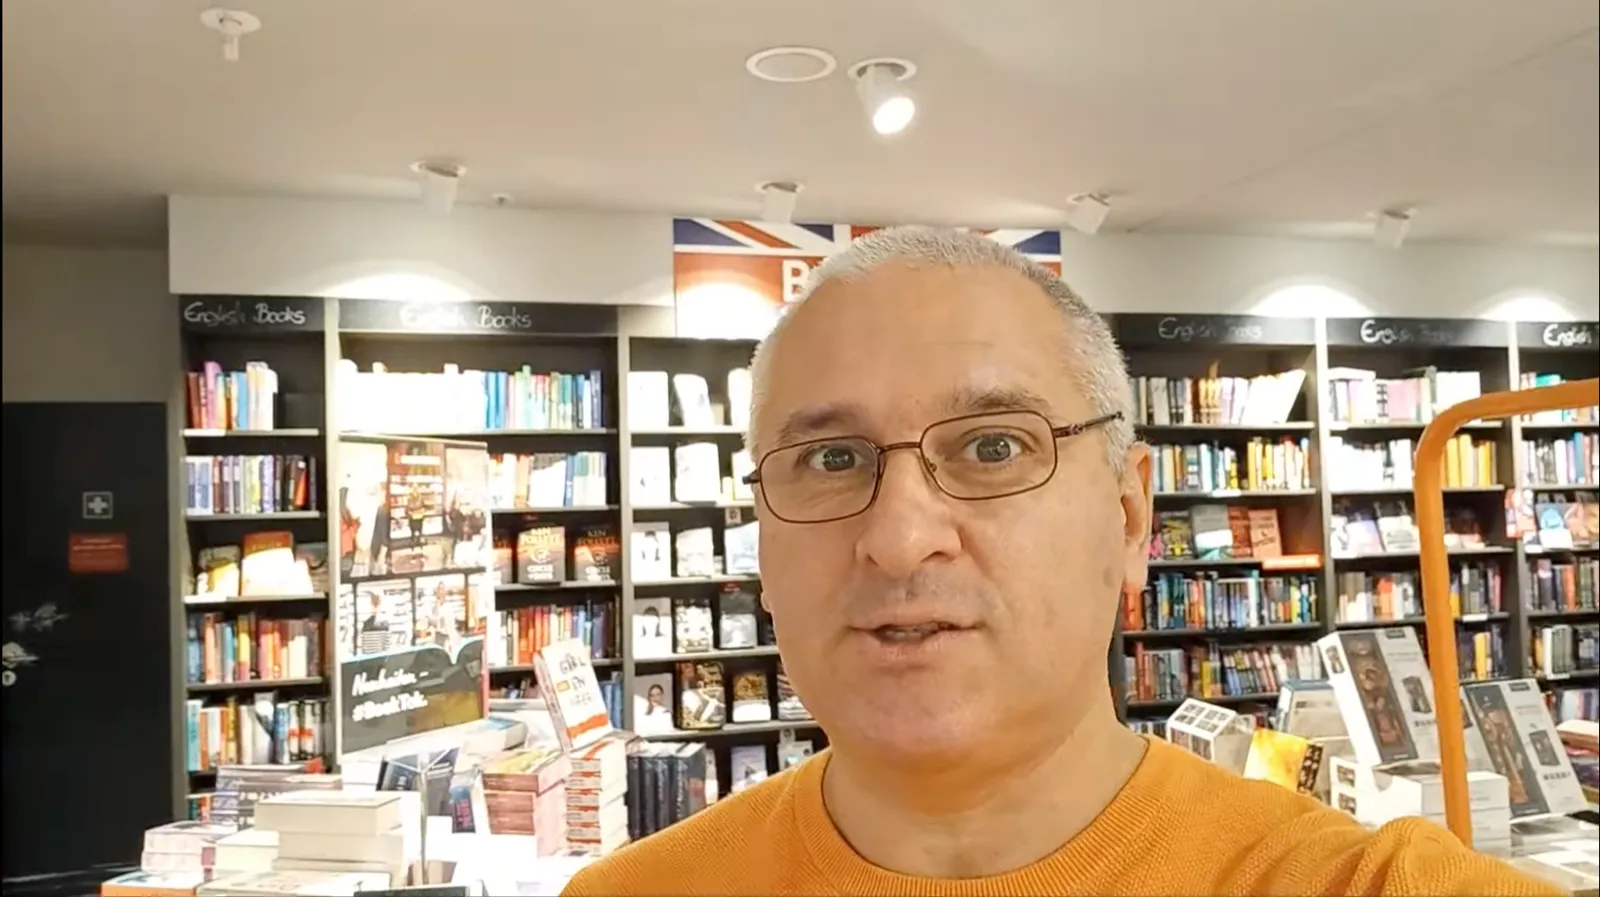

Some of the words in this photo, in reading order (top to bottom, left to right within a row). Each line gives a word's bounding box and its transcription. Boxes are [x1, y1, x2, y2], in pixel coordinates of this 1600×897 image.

[183, 301, 246, 327] English
[253, 302, 306, 325] Books
[475, 303, 532, 329] Books
